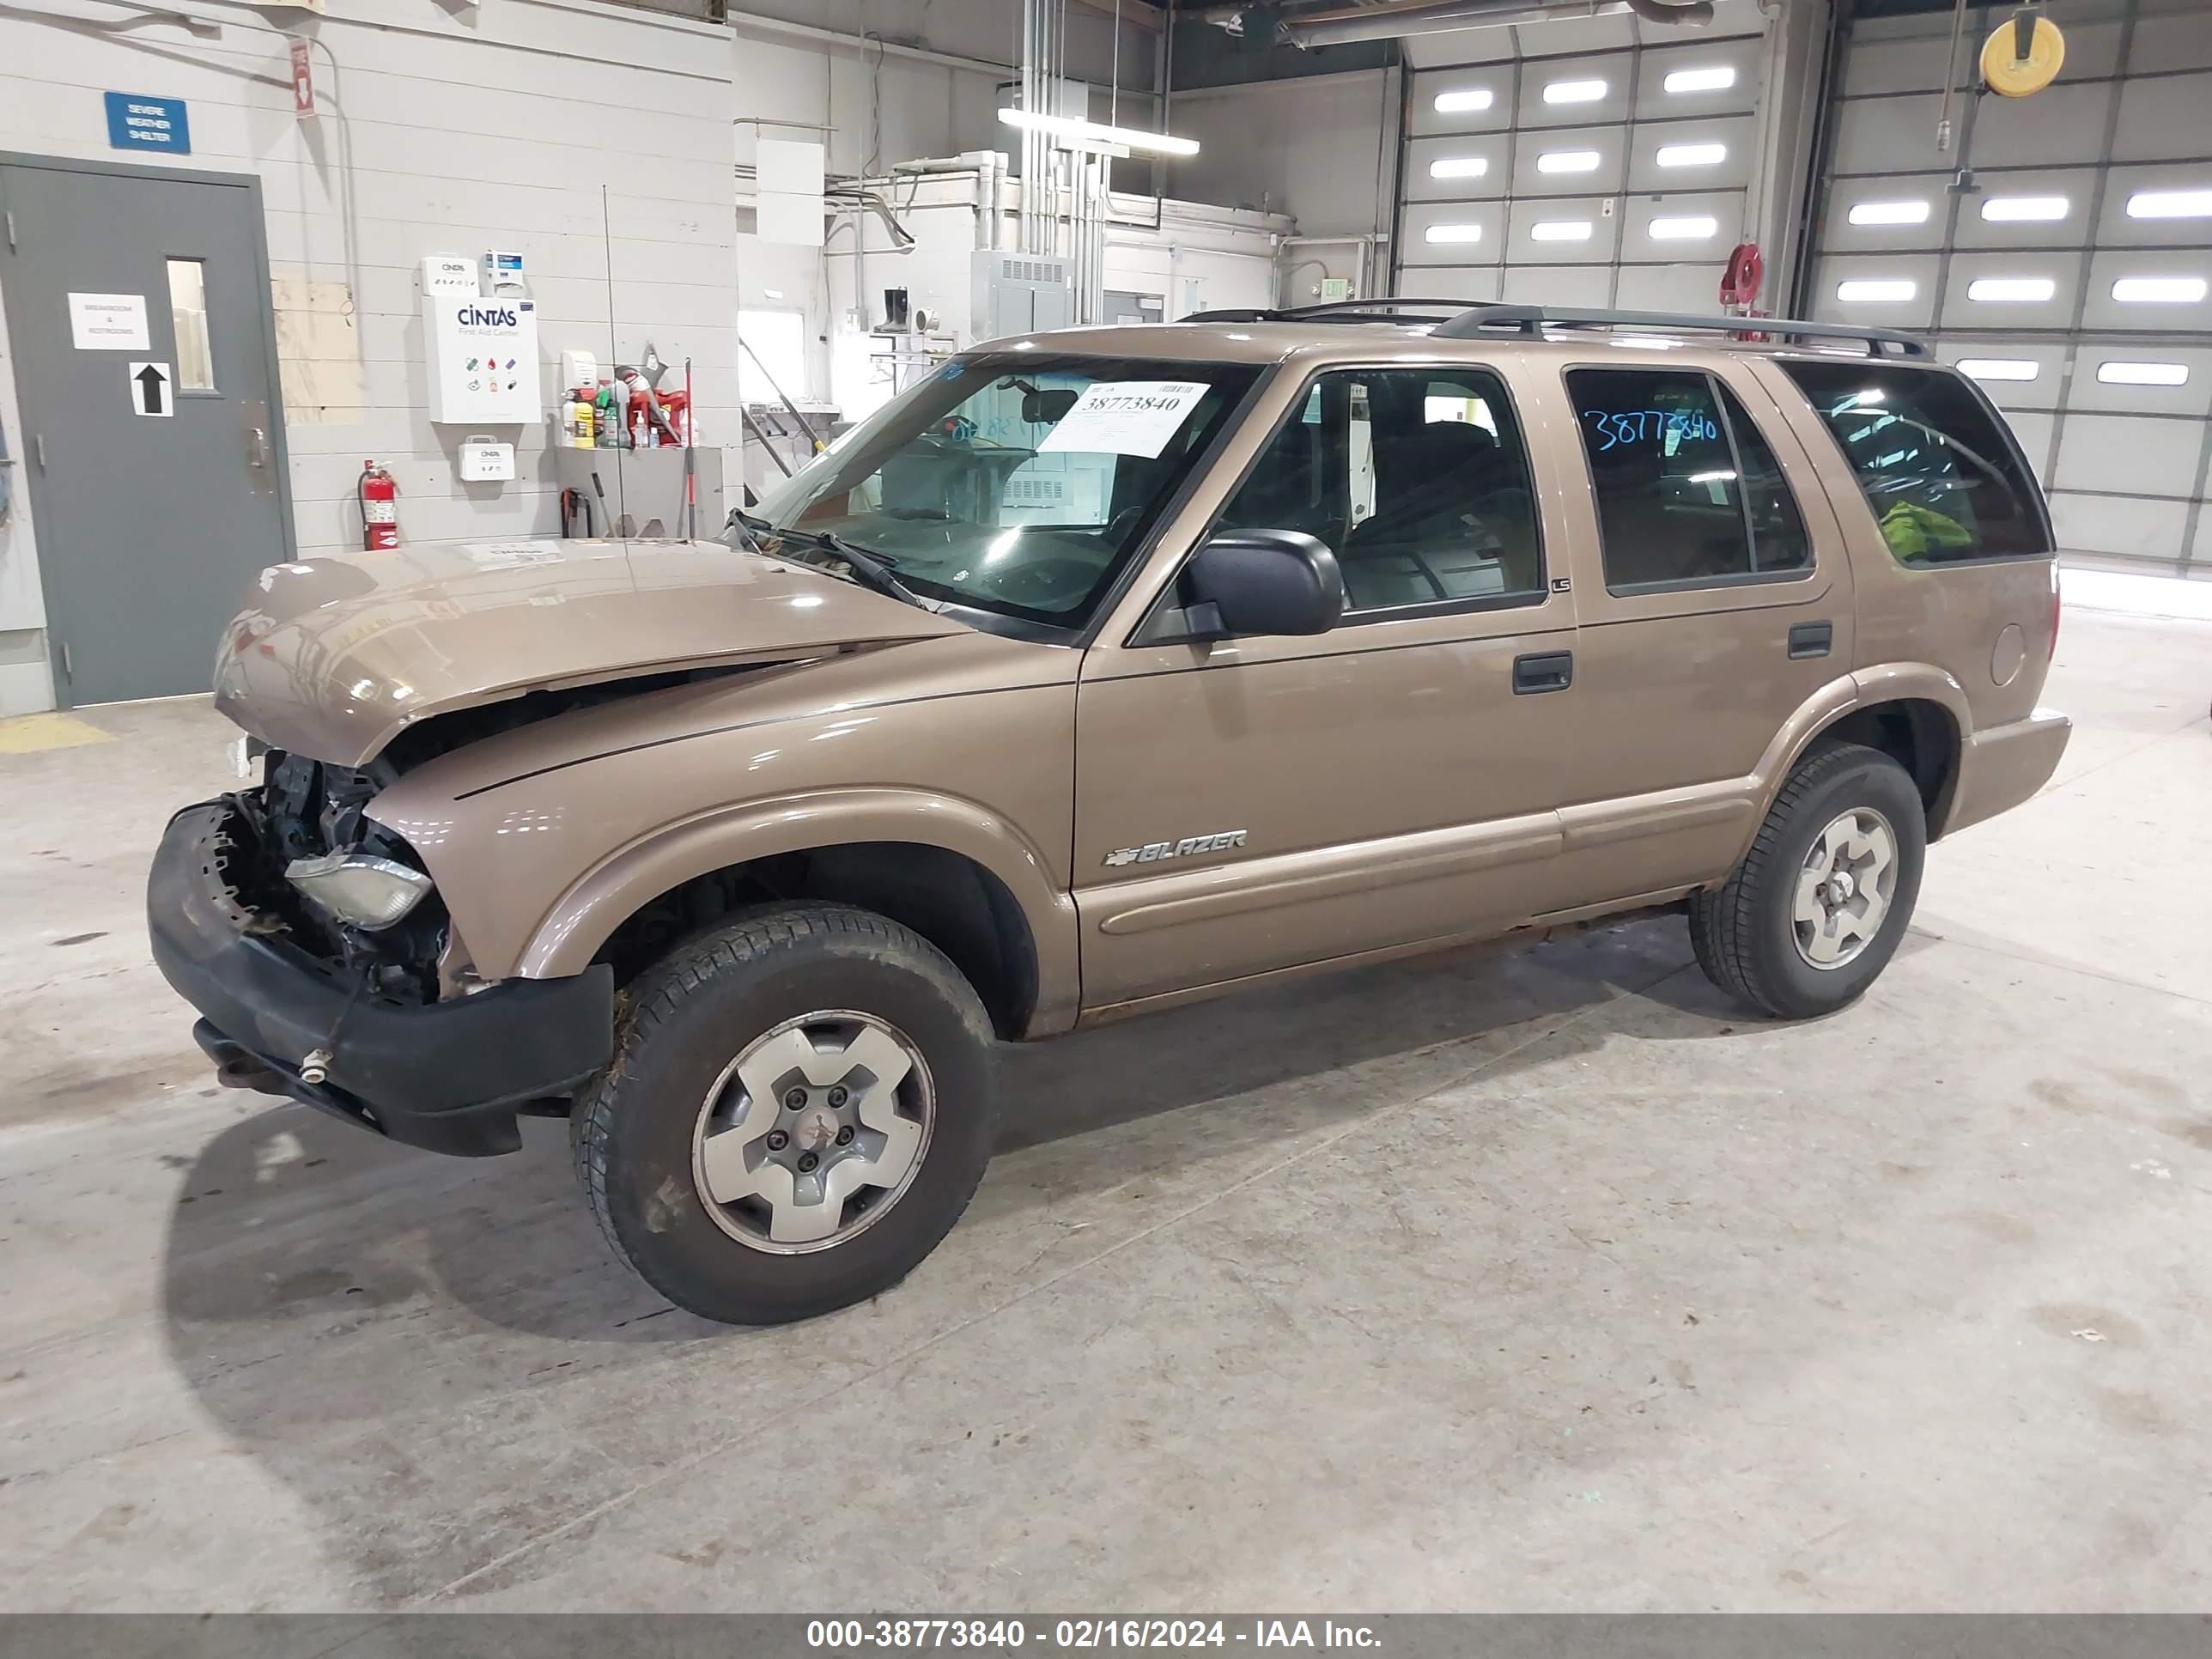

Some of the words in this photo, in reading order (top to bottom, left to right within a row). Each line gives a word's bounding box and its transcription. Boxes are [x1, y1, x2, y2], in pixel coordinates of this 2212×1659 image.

[127, 104, 167, 117] SEVERE
[125, 117, 171, 130] WEATHER
[128, 130, 171, 143] SHELTER
[1081, 397, 1180, 411] 38773840
[1584, 410, 1717, 451] 38773840
[1553, 580, 1570, 592] LS
[1135, 829, 1248, 864] BLAZER
